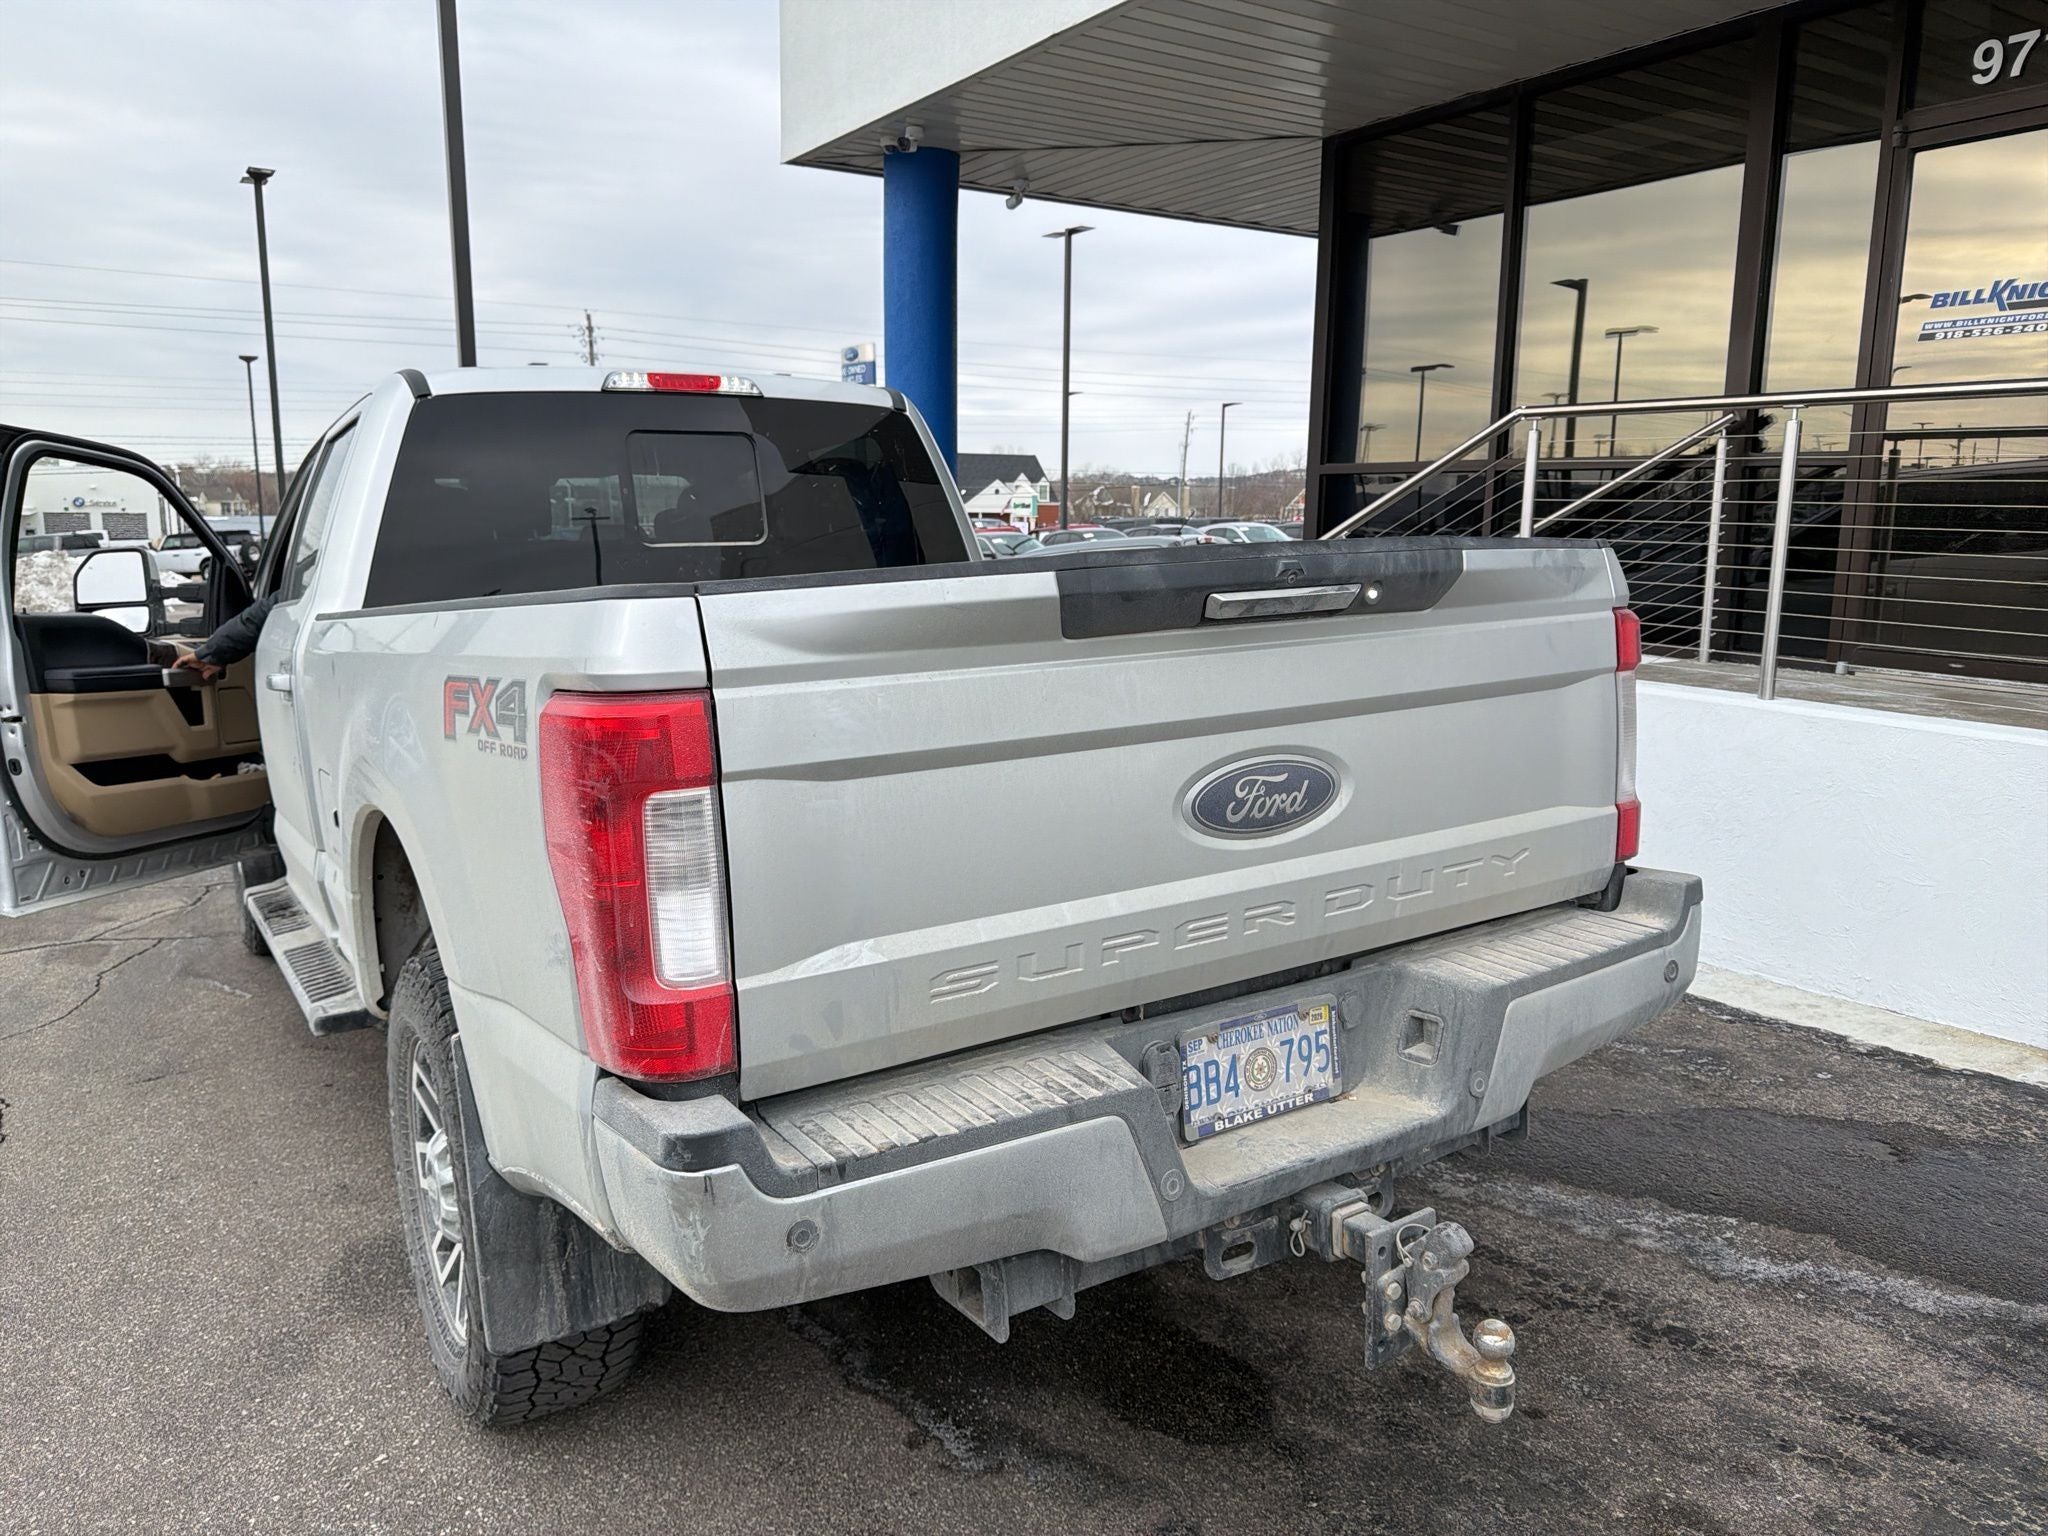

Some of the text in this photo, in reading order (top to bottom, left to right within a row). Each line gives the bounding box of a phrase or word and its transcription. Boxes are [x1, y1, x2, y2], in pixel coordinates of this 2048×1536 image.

[1972, 28, 2048, 86] 97
[1935, 323, 2048, 340] 918-526-240
[444, 674, 527, 743] FX4
[477, 739, 528, 760] OFF ROAD
[1226, 771, 1308, 823] Ford
[929, 846, 1530, 1001] SUPER DUTY
[1188, 1038, 1203, 1053] SEP
[1217, 1024, 1265, 1050] CHEROKEE
[1267, 1013, 1300, 1038] NATION
[1187, 1053, 1240, 1111] BB4
[1280, 1029, 1330, 1083] 795
[1214, 1108, 1263, 1132] BLAKE
[1267, 1093, 1314, 1115] UTTER
